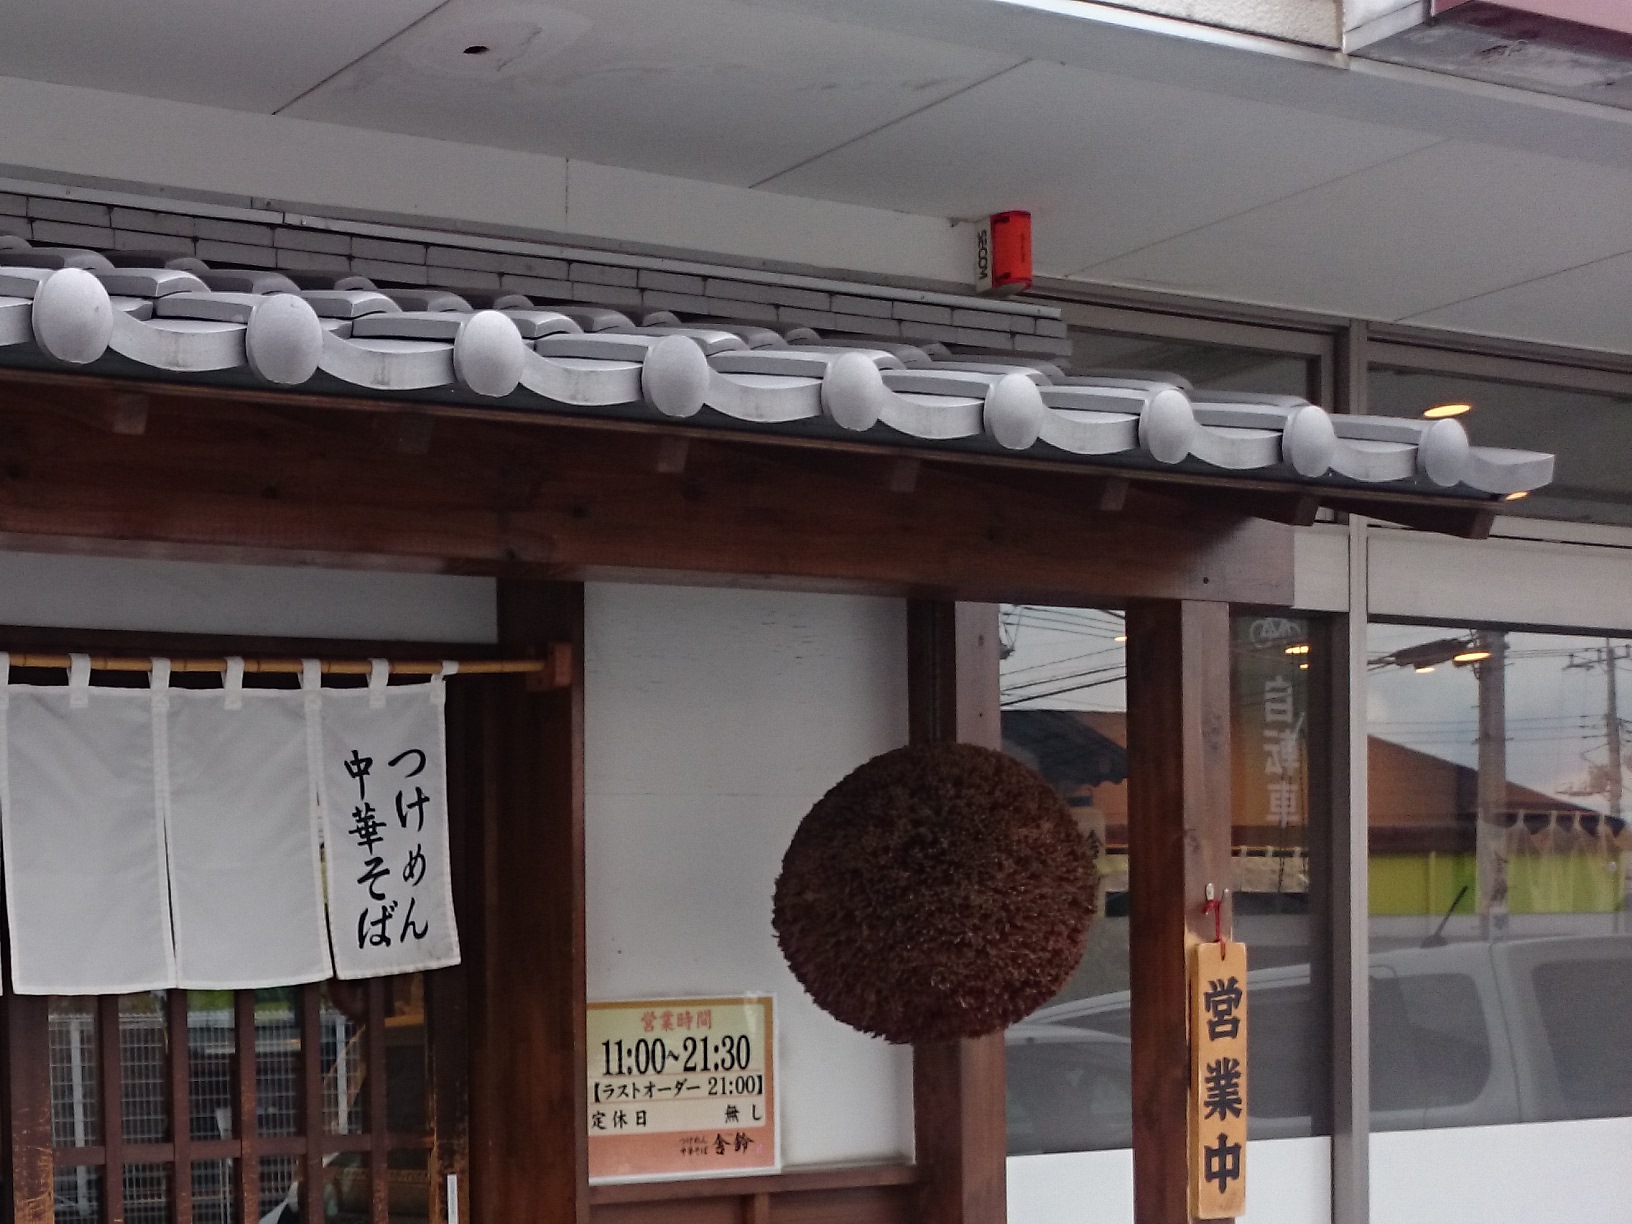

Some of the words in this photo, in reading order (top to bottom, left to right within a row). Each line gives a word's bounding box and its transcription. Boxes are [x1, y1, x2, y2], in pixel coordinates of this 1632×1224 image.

[343, 748, 395, 950] 中華そば
[387, 748, 430, 943] つけめん
[640, 1009, 712, 1032] 営業時間
[1203, 977, 1242, 1194] 営業中
[591, 1110, 648, 1130] 定休日
